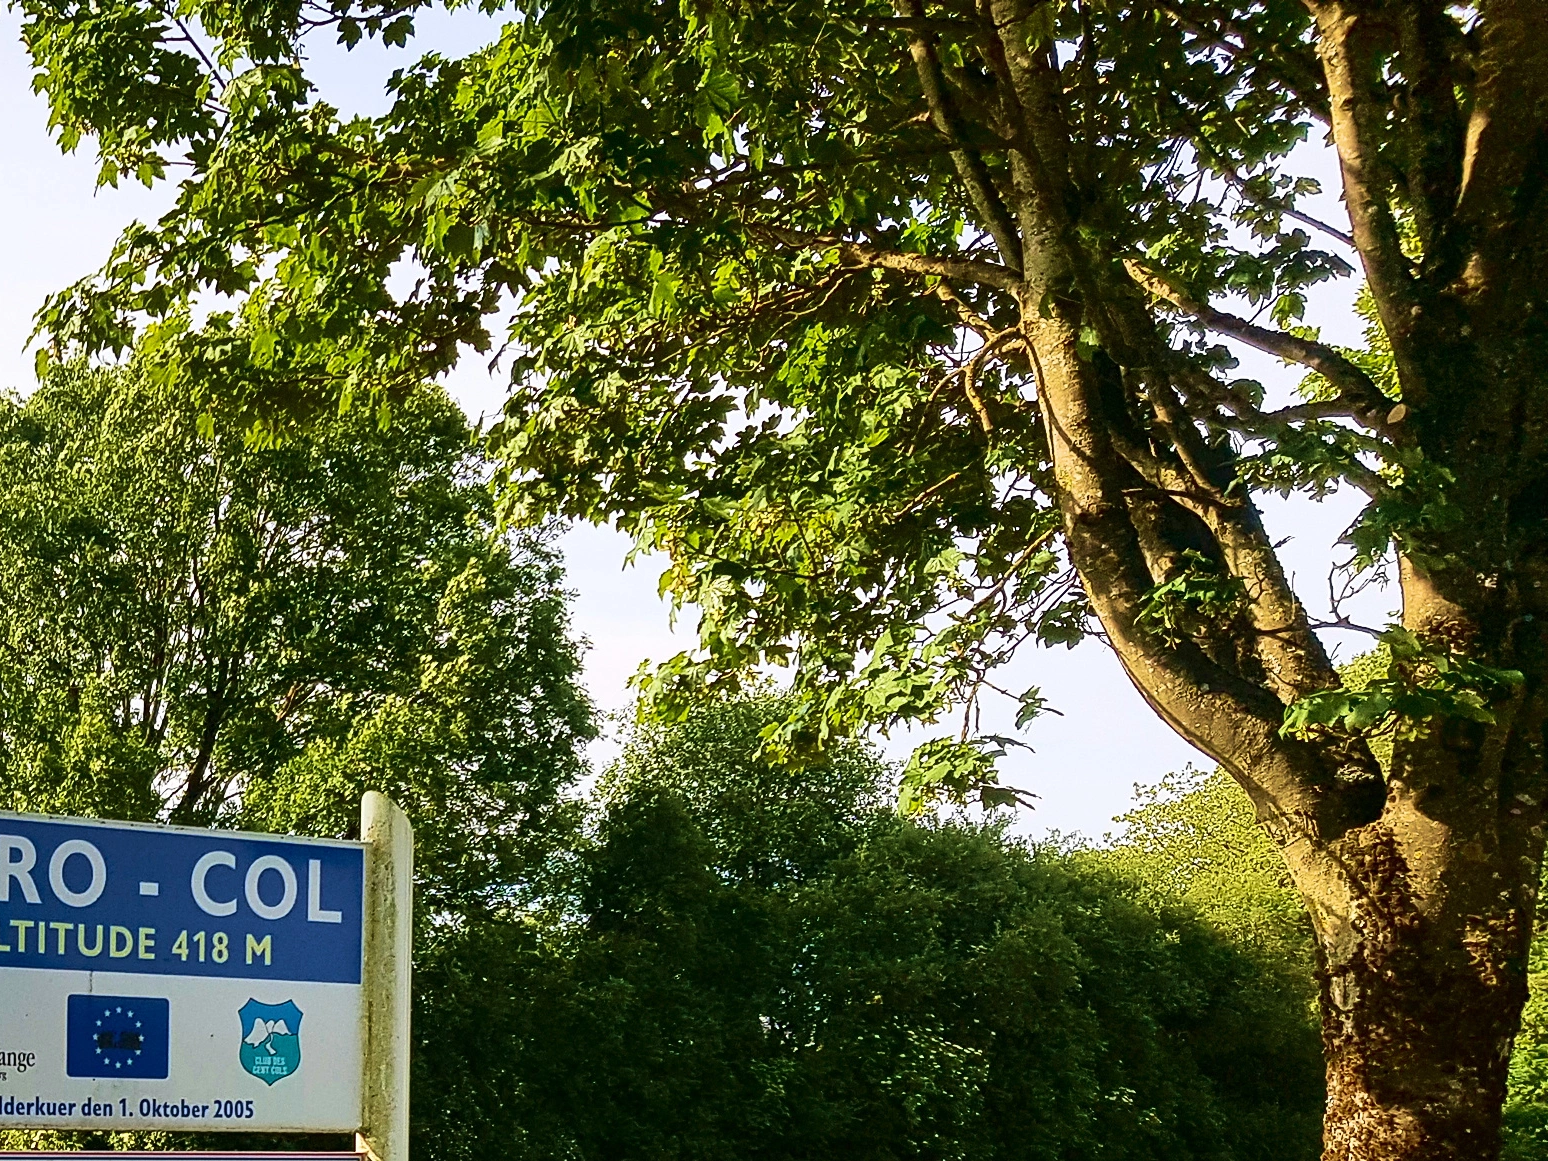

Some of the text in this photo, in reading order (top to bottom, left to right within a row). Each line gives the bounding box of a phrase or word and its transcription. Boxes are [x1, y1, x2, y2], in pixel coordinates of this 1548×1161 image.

[190, 850, 343, 924] COL
[173, 930, 228, 964] 418
[247, 933, 270, 966] M
[81, 1097, 112, 1117] den
[119, 1098, 133, 1117] 1.
[140, 1098, 209, 1118] Oktober
[214, 1099, 253, 1118] 2005
